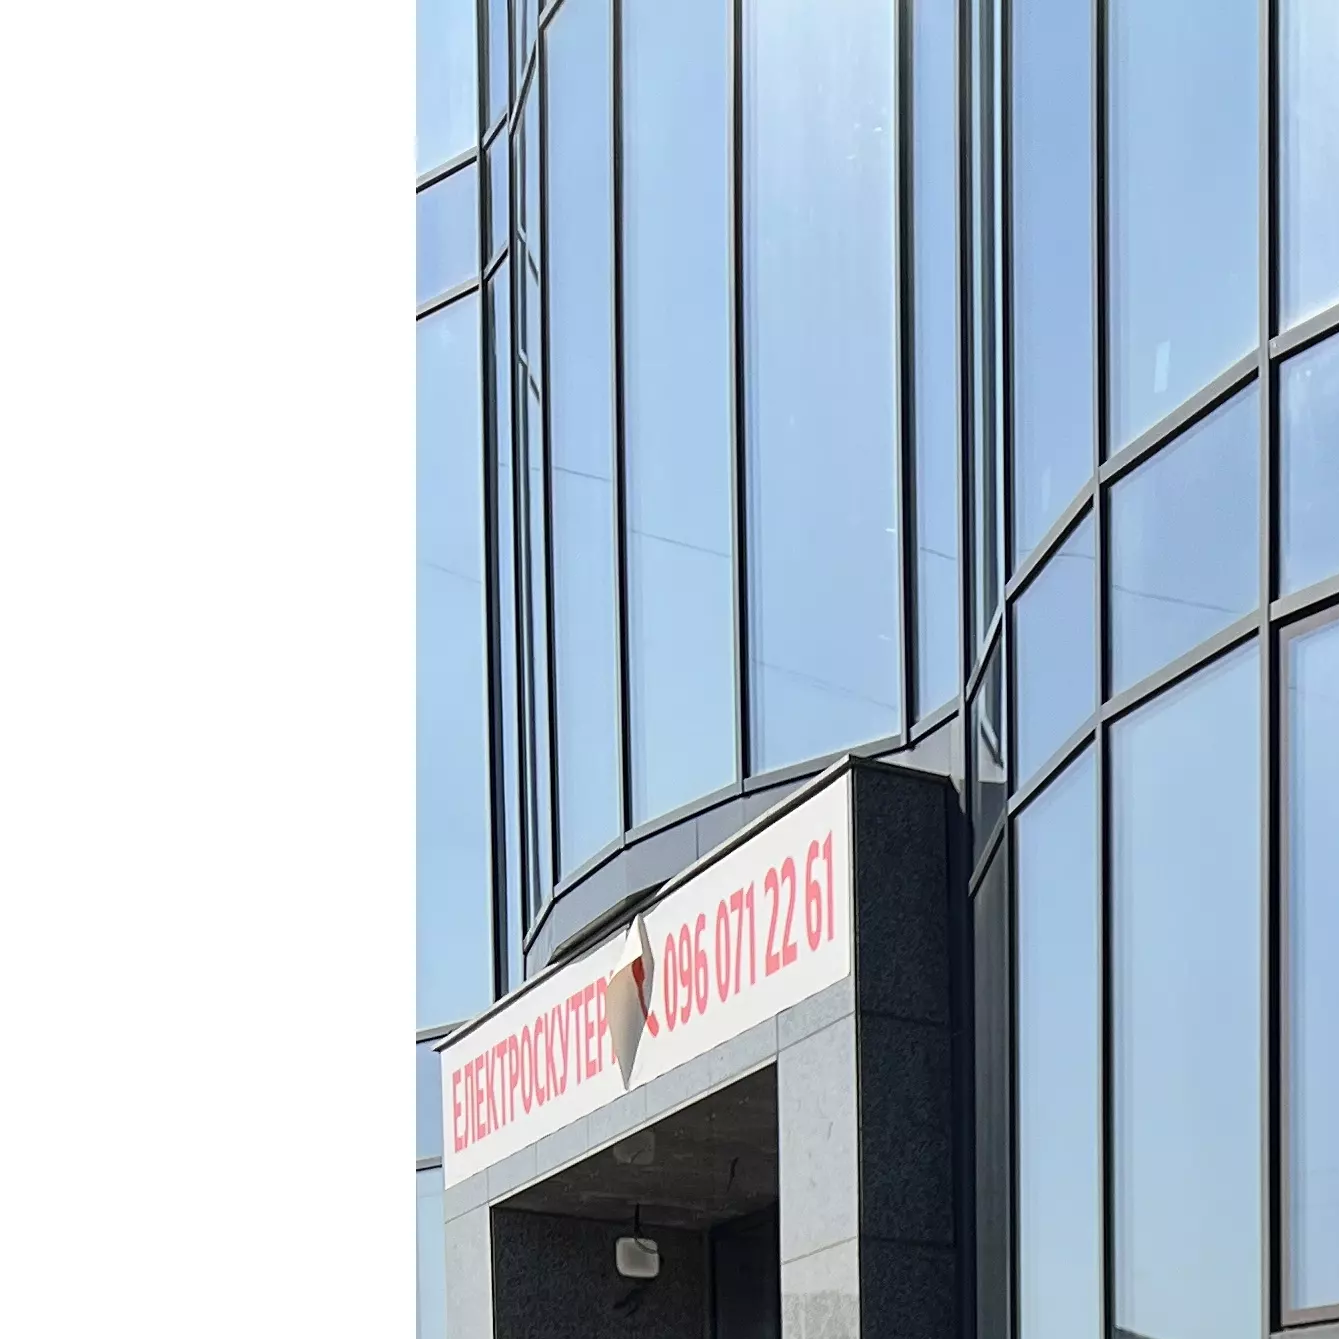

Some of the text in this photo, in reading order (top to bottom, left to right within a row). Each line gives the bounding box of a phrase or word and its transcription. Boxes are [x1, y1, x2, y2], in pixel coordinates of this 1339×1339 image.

[452, 830, 836, 1154] ЕЛЕКТРОСКУТЕР 096 071 22 61
